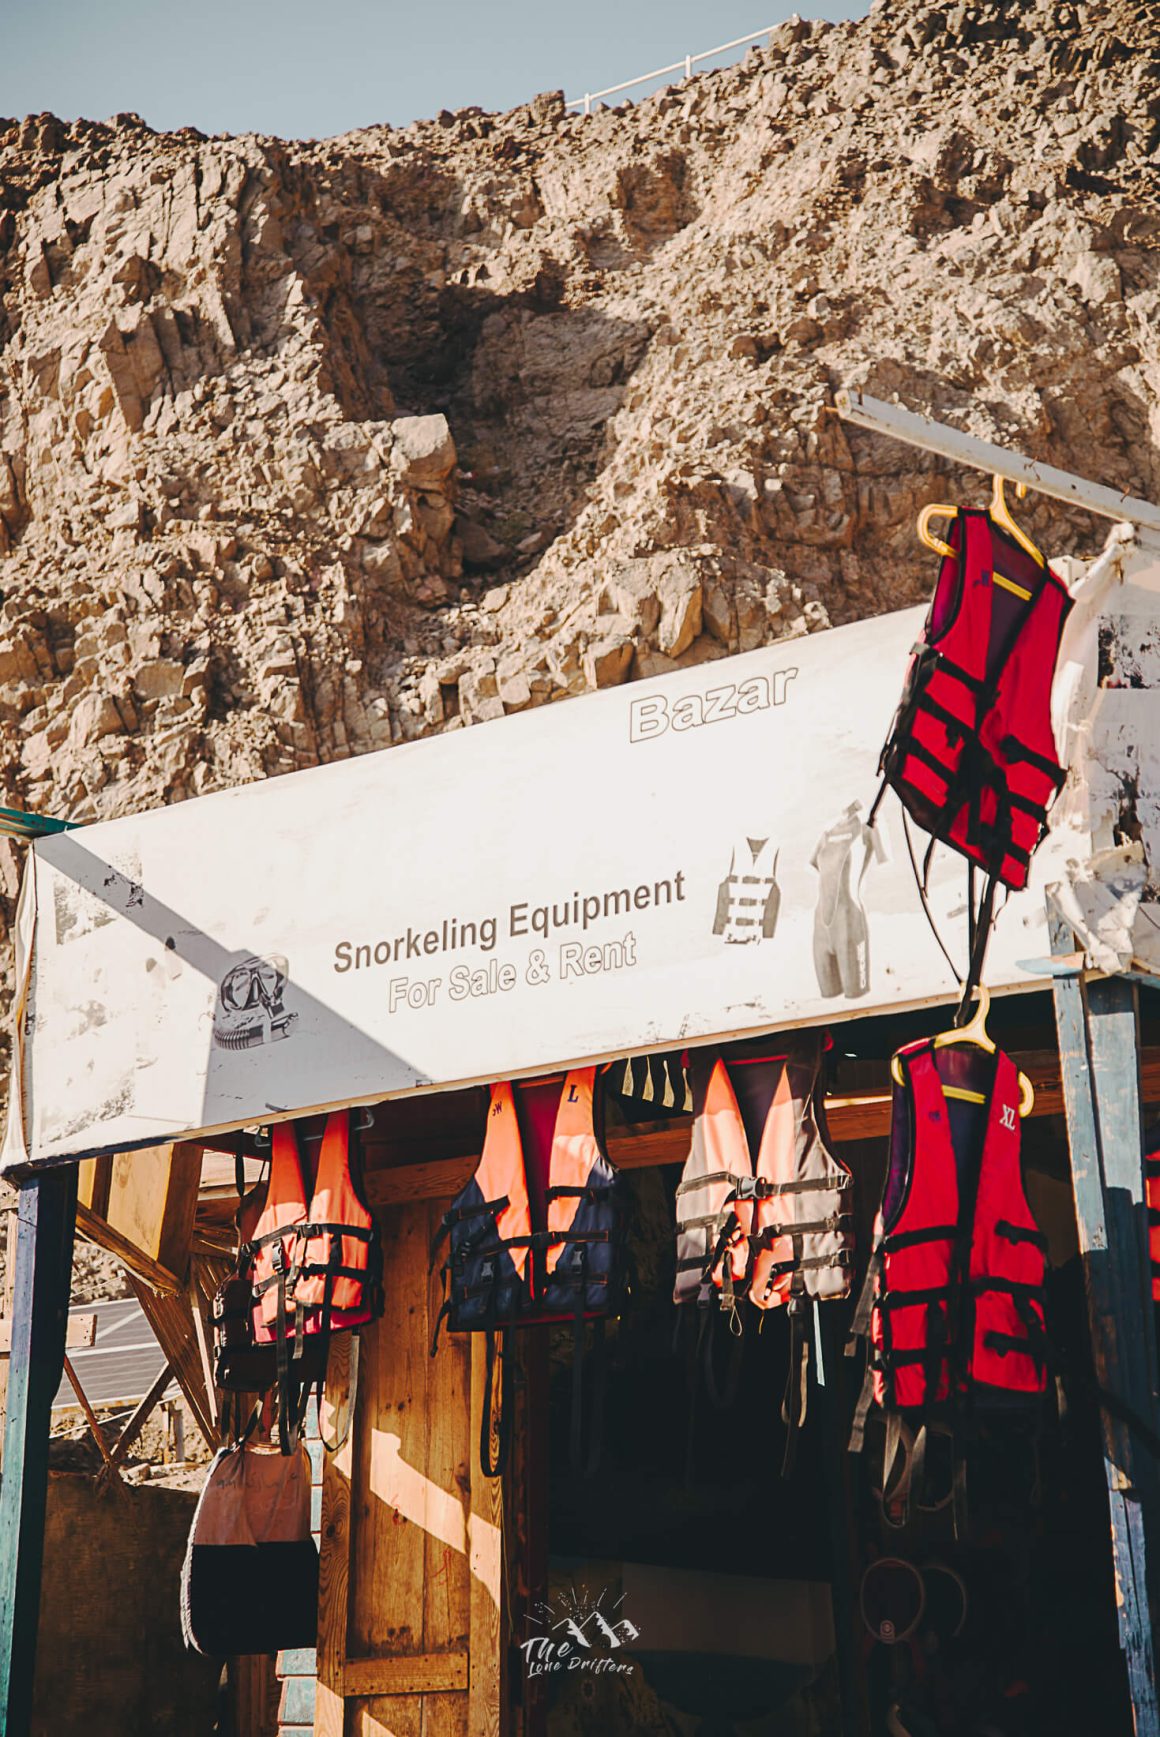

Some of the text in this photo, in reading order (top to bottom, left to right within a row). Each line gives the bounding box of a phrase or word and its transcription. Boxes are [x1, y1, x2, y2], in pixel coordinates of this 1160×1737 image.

[629, 667, 798, 743] Bazar
[333, 870, 686, 973] Snorkeling Equipment
[388, 931, 638, 1013] For Sale & Rent
[567, 1084, 579, 1103] L
[999, 1103, 1016, 1131] XL
